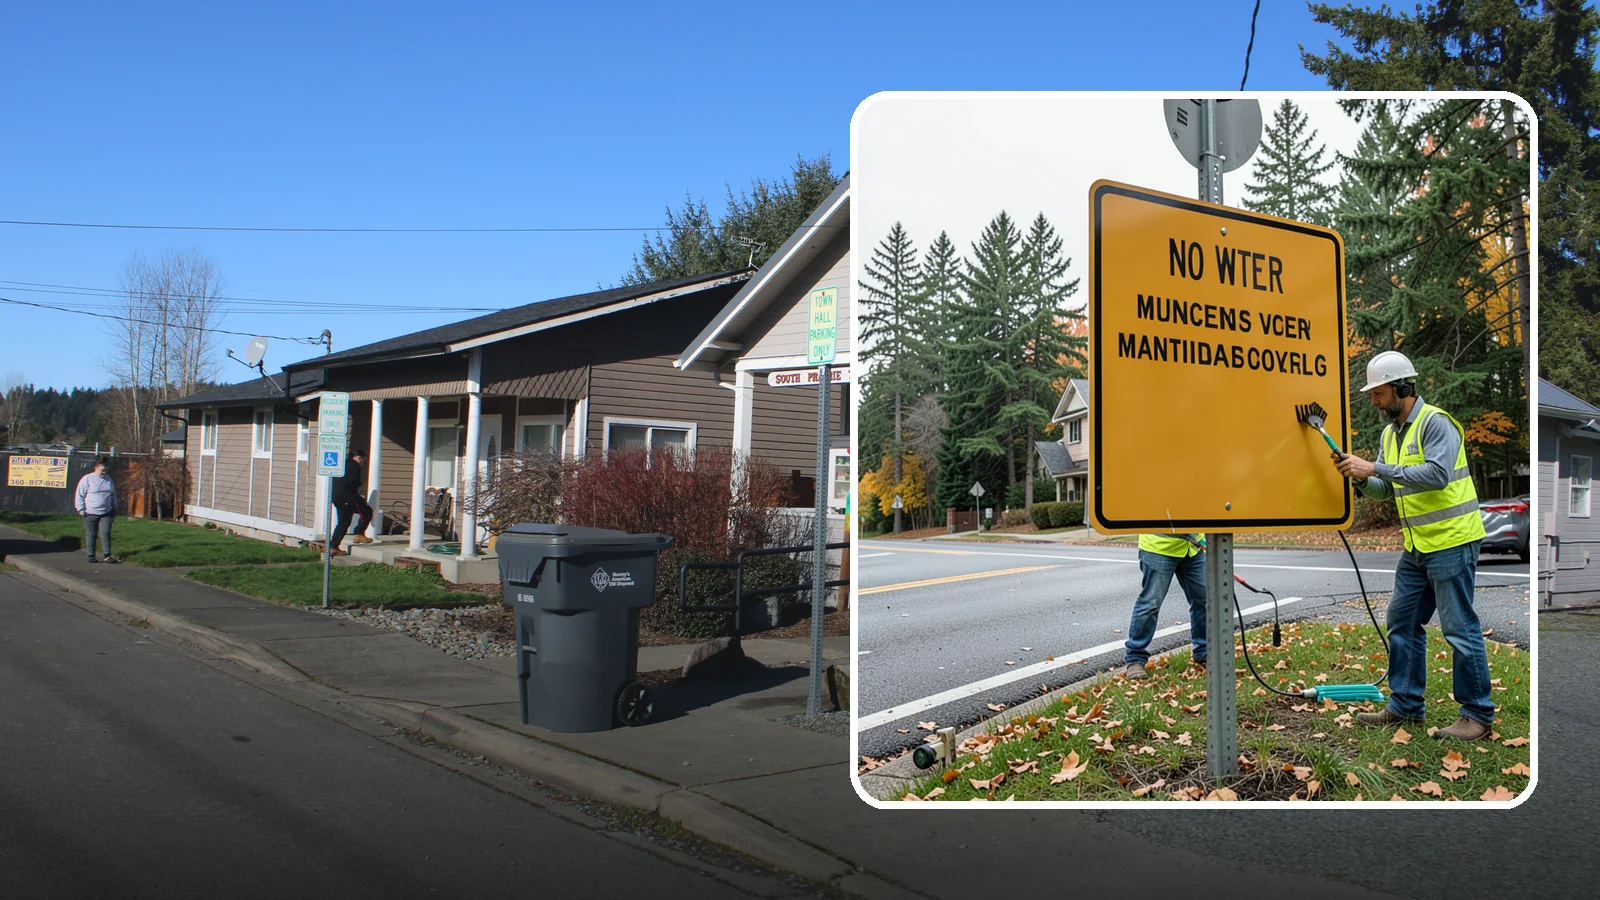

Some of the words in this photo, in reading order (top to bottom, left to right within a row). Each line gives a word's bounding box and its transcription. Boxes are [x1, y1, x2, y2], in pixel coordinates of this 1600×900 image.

[1169, 238, 1204, 281] NO
[1215, 245, 1283, 294] WTER
[815, 295, 833, 308] TOWN
[814, 312, 831, 324] HALL
[1137, 294, 1252, 333] MUNCENS
[810, 327, 836, 340] PARKING
[813, 344, 831, 357] ONLY
[775, 373, 801, 384] SOUTH
